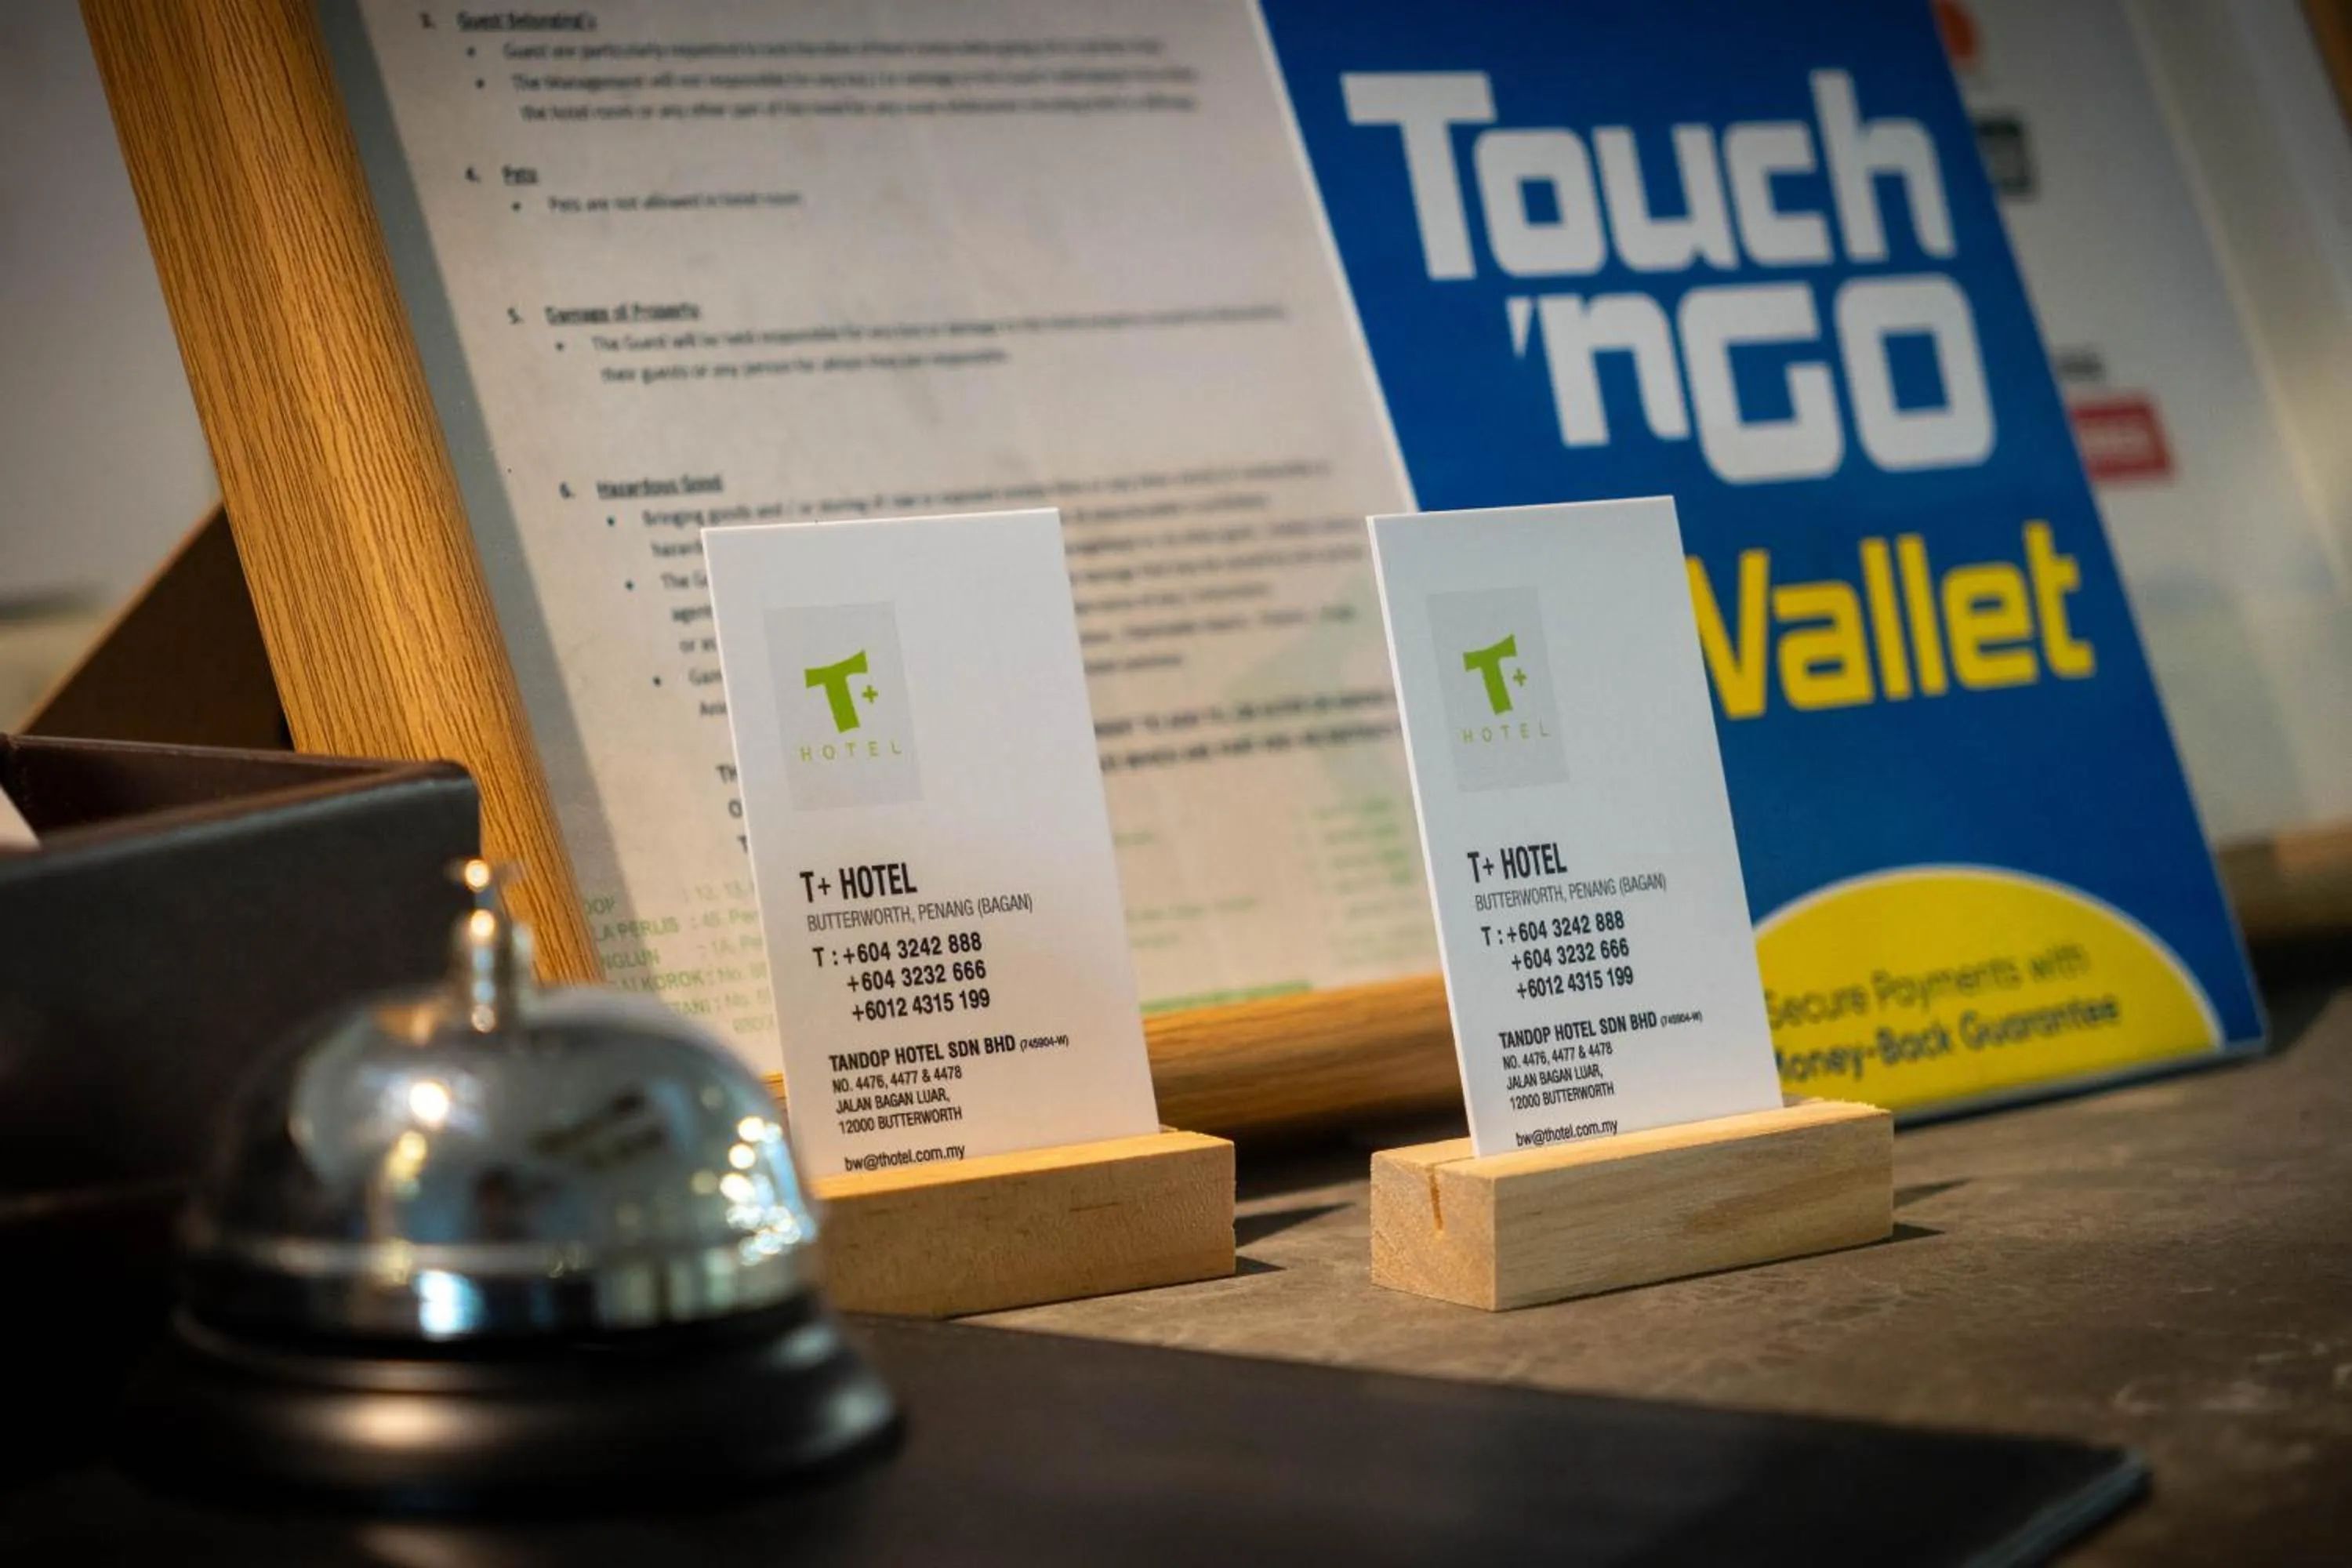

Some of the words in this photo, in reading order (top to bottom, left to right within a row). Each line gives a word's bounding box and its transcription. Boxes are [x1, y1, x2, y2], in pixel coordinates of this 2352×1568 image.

[1339, 67, 1958, 282] Touch
[1461, 717, 1552, 743] HOTEL
[800, 739, 902, 763] HOTEL
[1467, 851, 1494, 884] T+
[1500, 843, 1568, 880] HOTEL
[800, 871, 831, 903] T+
[839, 862, 917, 900] HOTEL
[1475, 885, 1567, 912] BUTTERWORTH,
[1569, 878, 1617, 900] PENANG
[1619, 872, 1667, 897] (BAGAN)
[808, 905, 916, 932] BUTTERWORTH,
[918, 899, 975, 922] PENANG
[978, 893, 1033, 919] (BAGAN)
[1506, 920, 1548, 943] +604
[1552, 914, 1592, 938] 3242
[1595, 910, 1625, 931] 888
[843, 941, 891, 965] +604
[898, 936, 942, 960] 3242
[948, 931, 982, 953] 888
[1512, 948, 1552, 971] +604
[1556, 942, 1596, 965] 3232
[1600, 938, 1630, 959] 666
[847, 969, 896, 993] +604
[902, 964, 946, 987] 3232
[953, 960, 986, 982] 666
[1517, 975, 1565, 1000] +6012
[1567, 970, 1604, 992] 4315
[1606, 965, 1634, 985] 199
[1871, 954, 2022, 1011] Payments
[2027, 942, 2092, 983] with
[852, 997, 908, 1022] +6012
[912, 992, 954, 1015] 4315
[959, 988, 990, 1010] 199
[1498, 1026, 1552, 1049] TANDOP
[1555, 1021, 1596, 1042] HOTEL
[1599, 1015, 1627, 1035] SDN
[1629, 1011, 1657, 1030] BHD
[1959, 995, 2122, 1052] Guarantee
[829, 1050, 890, 1073] TANDOP
[895, 1044, 944, 1065] HOTEL
[948, 1039, 982, 1058] SDN
[983, 1034, 1016, 1054] BHD
[1502, 1055, 1521, 1071] NO.
[1523, 1051, 1551, 1068] 4476,
[1552, 1047, 1575, 1063] 4477
[1578, 1045, 1586, 1059] &
[1588, 1041, 1613, 1057] 4478
[832, 1078, 853, 1094] NO.
[855, 1074, 888, 1091] 4476,
[890, 1070, 918, 1086] 4477
[922, 1069, 931, 1083] &
[933, 1065, 963, 1080] 4478
[1506, 1073, 1538, 1091] JALAN
[1539, 1067, 1573, 1085] BAGAN
[1574, 1063, 1603, 1080] LUAR,
[836, 1096, 873, 1114] JALAN
[875, 1091, 913, 1109] BAGAN
[916, 1087, 950, 1105] LUAR,
[1509, 1094, 1541, 1111] 12000
[1542, 1082, 1615, 1106] BUTTERWORTH
[839, 1116, 875, 1134] 12000
[877, 1106, 963, 1130] BUTTERWORTH
[1515, 1120, 1618, 1147] bw@thotel.com.my
[844, 1144, 966, 1171] bw@thotel.com.my
